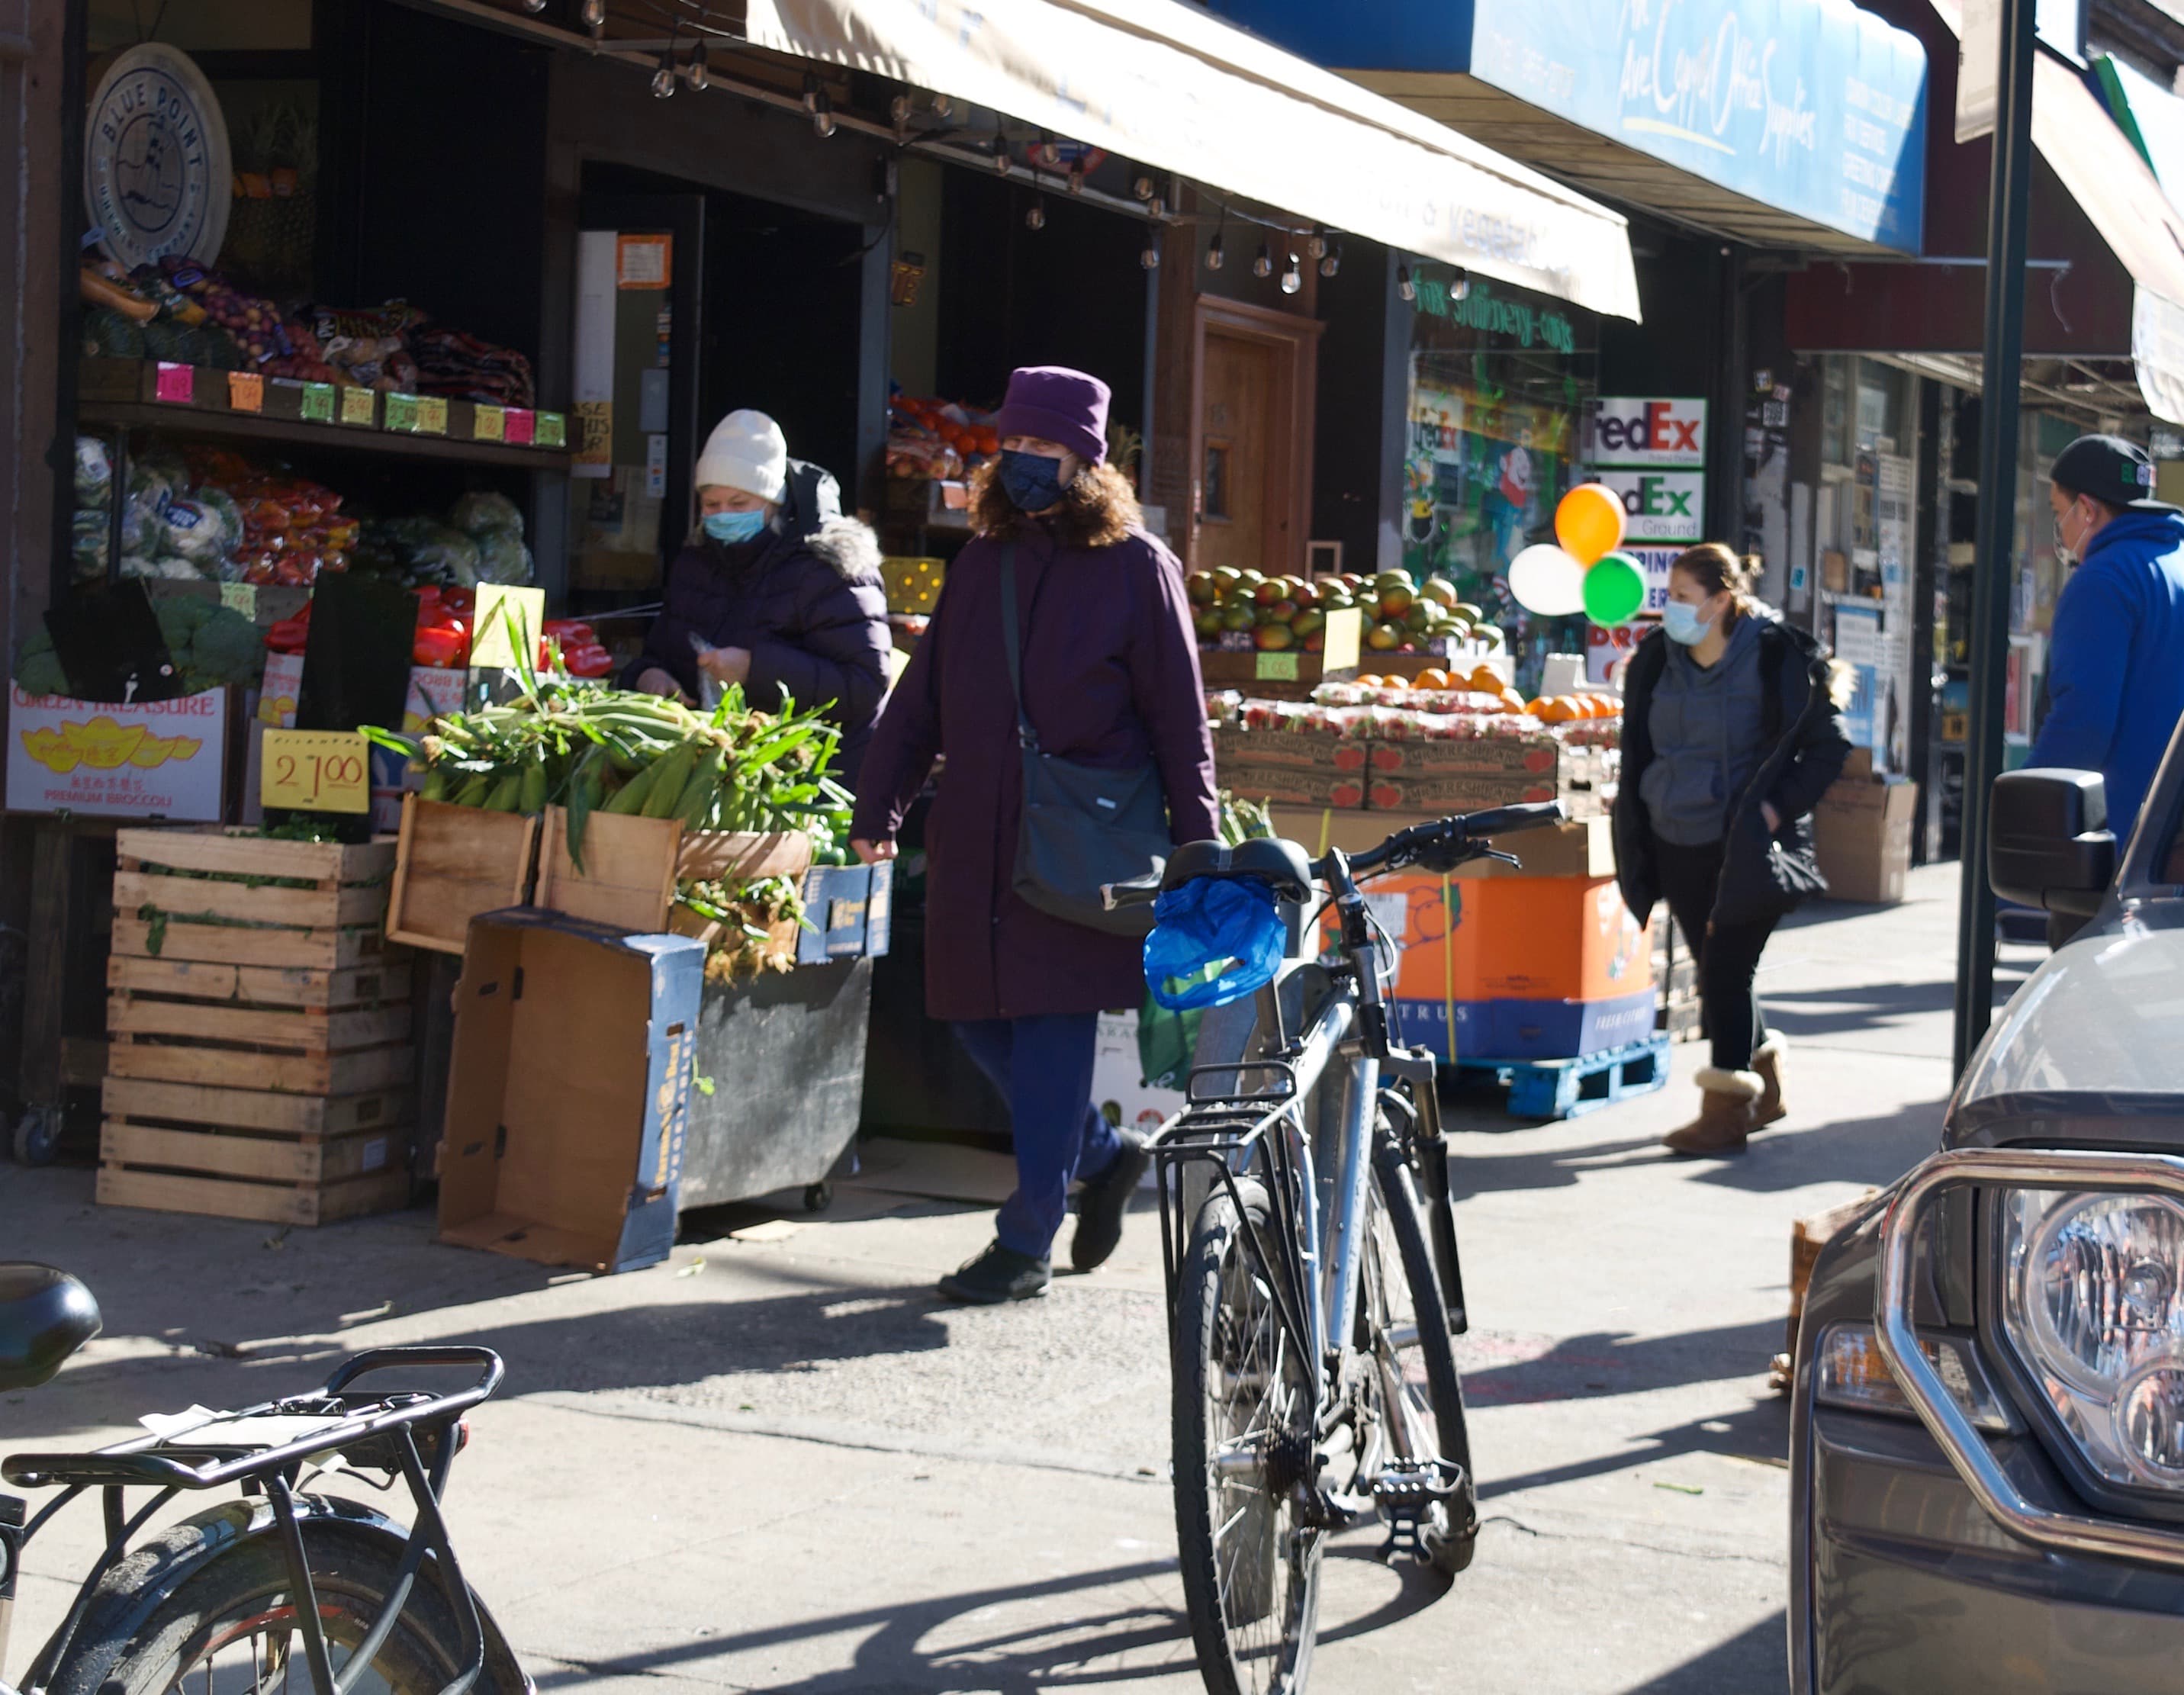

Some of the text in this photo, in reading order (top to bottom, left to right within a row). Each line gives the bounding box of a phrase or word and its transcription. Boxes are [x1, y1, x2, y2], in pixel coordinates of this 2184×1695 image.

[101, 82, 204, 166] BLUE POINT
[1584, 400, 1701, 452] FedEx
[1619, 476, 1693, 517] dEx
[1642, 519, 1697, 538] Ground
[275, 754, 300, 786] 2
[43, 789, 172, 808] PREMIUM BROCCOLI
